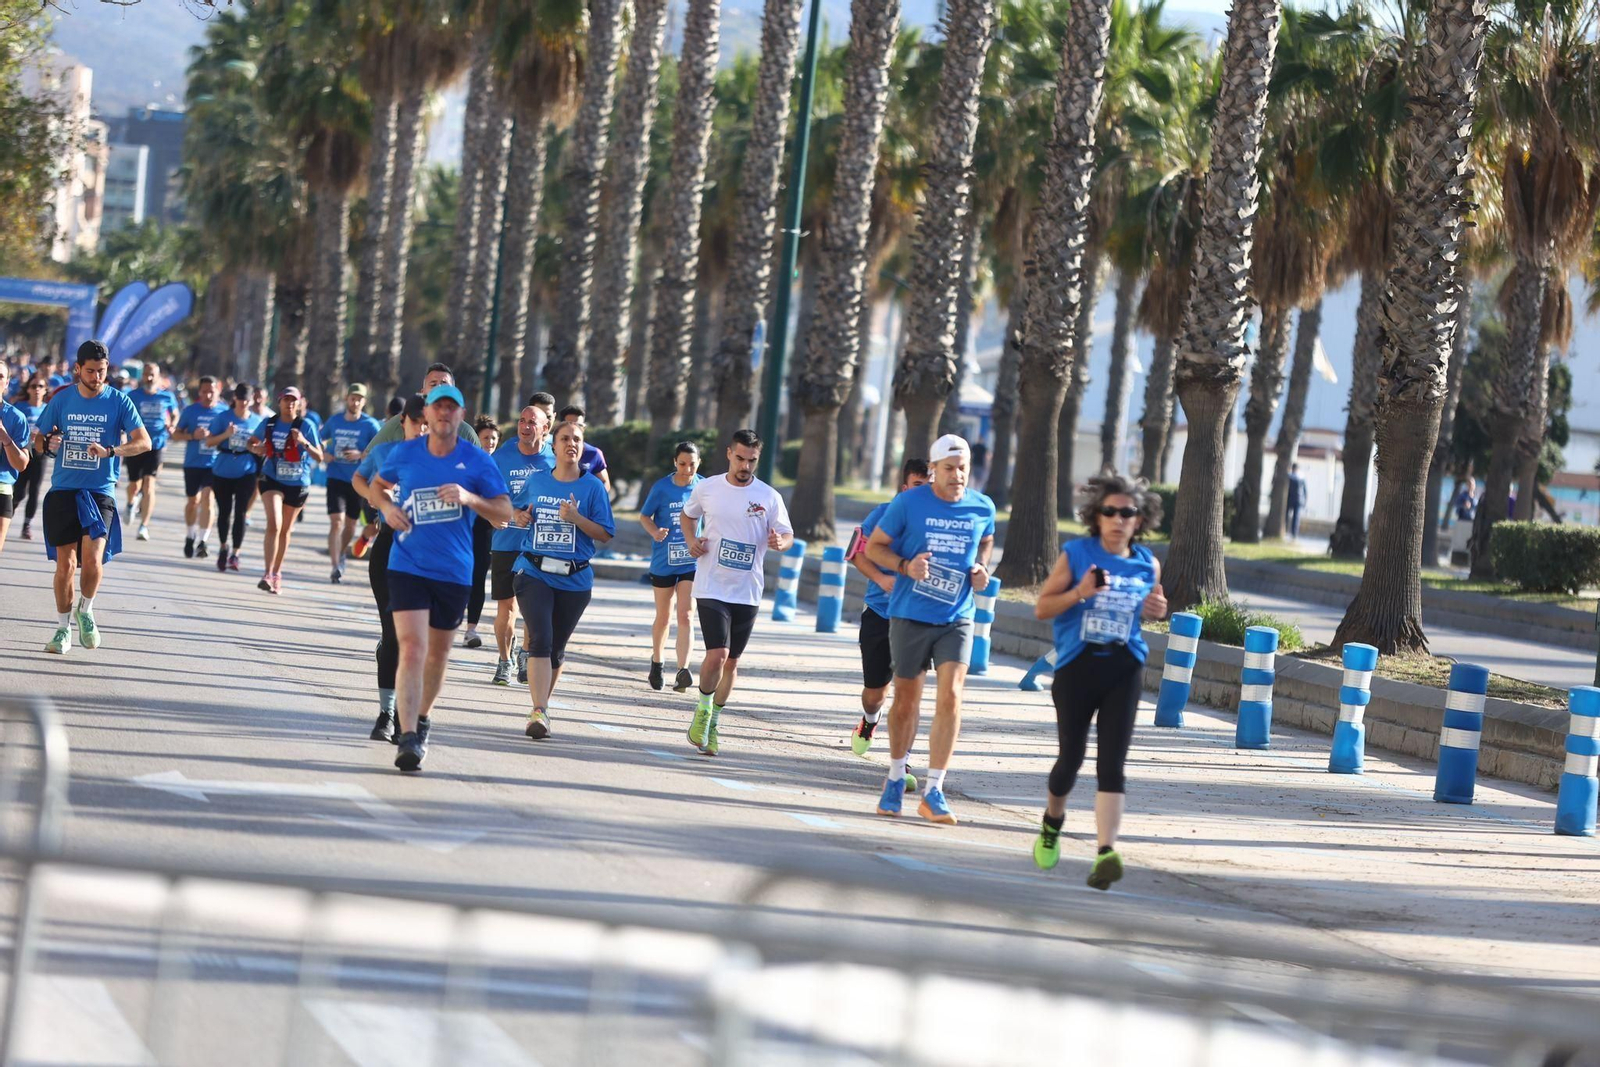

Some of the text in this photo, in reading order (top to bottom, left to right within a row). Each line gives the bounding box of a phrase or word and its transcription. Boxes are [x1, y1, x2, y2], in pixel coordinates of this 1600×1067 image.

[67, 413, 108, 423] mayoral
[537, 495, 581, 509] mayorl
[925, 517, 975, 530] mayoral
[540, 533, 570, 543] 1872
[672, 550, 691, 558] 192
[722, 549, 752, 562] 2065
[923, 575, 956, 592] 2012
